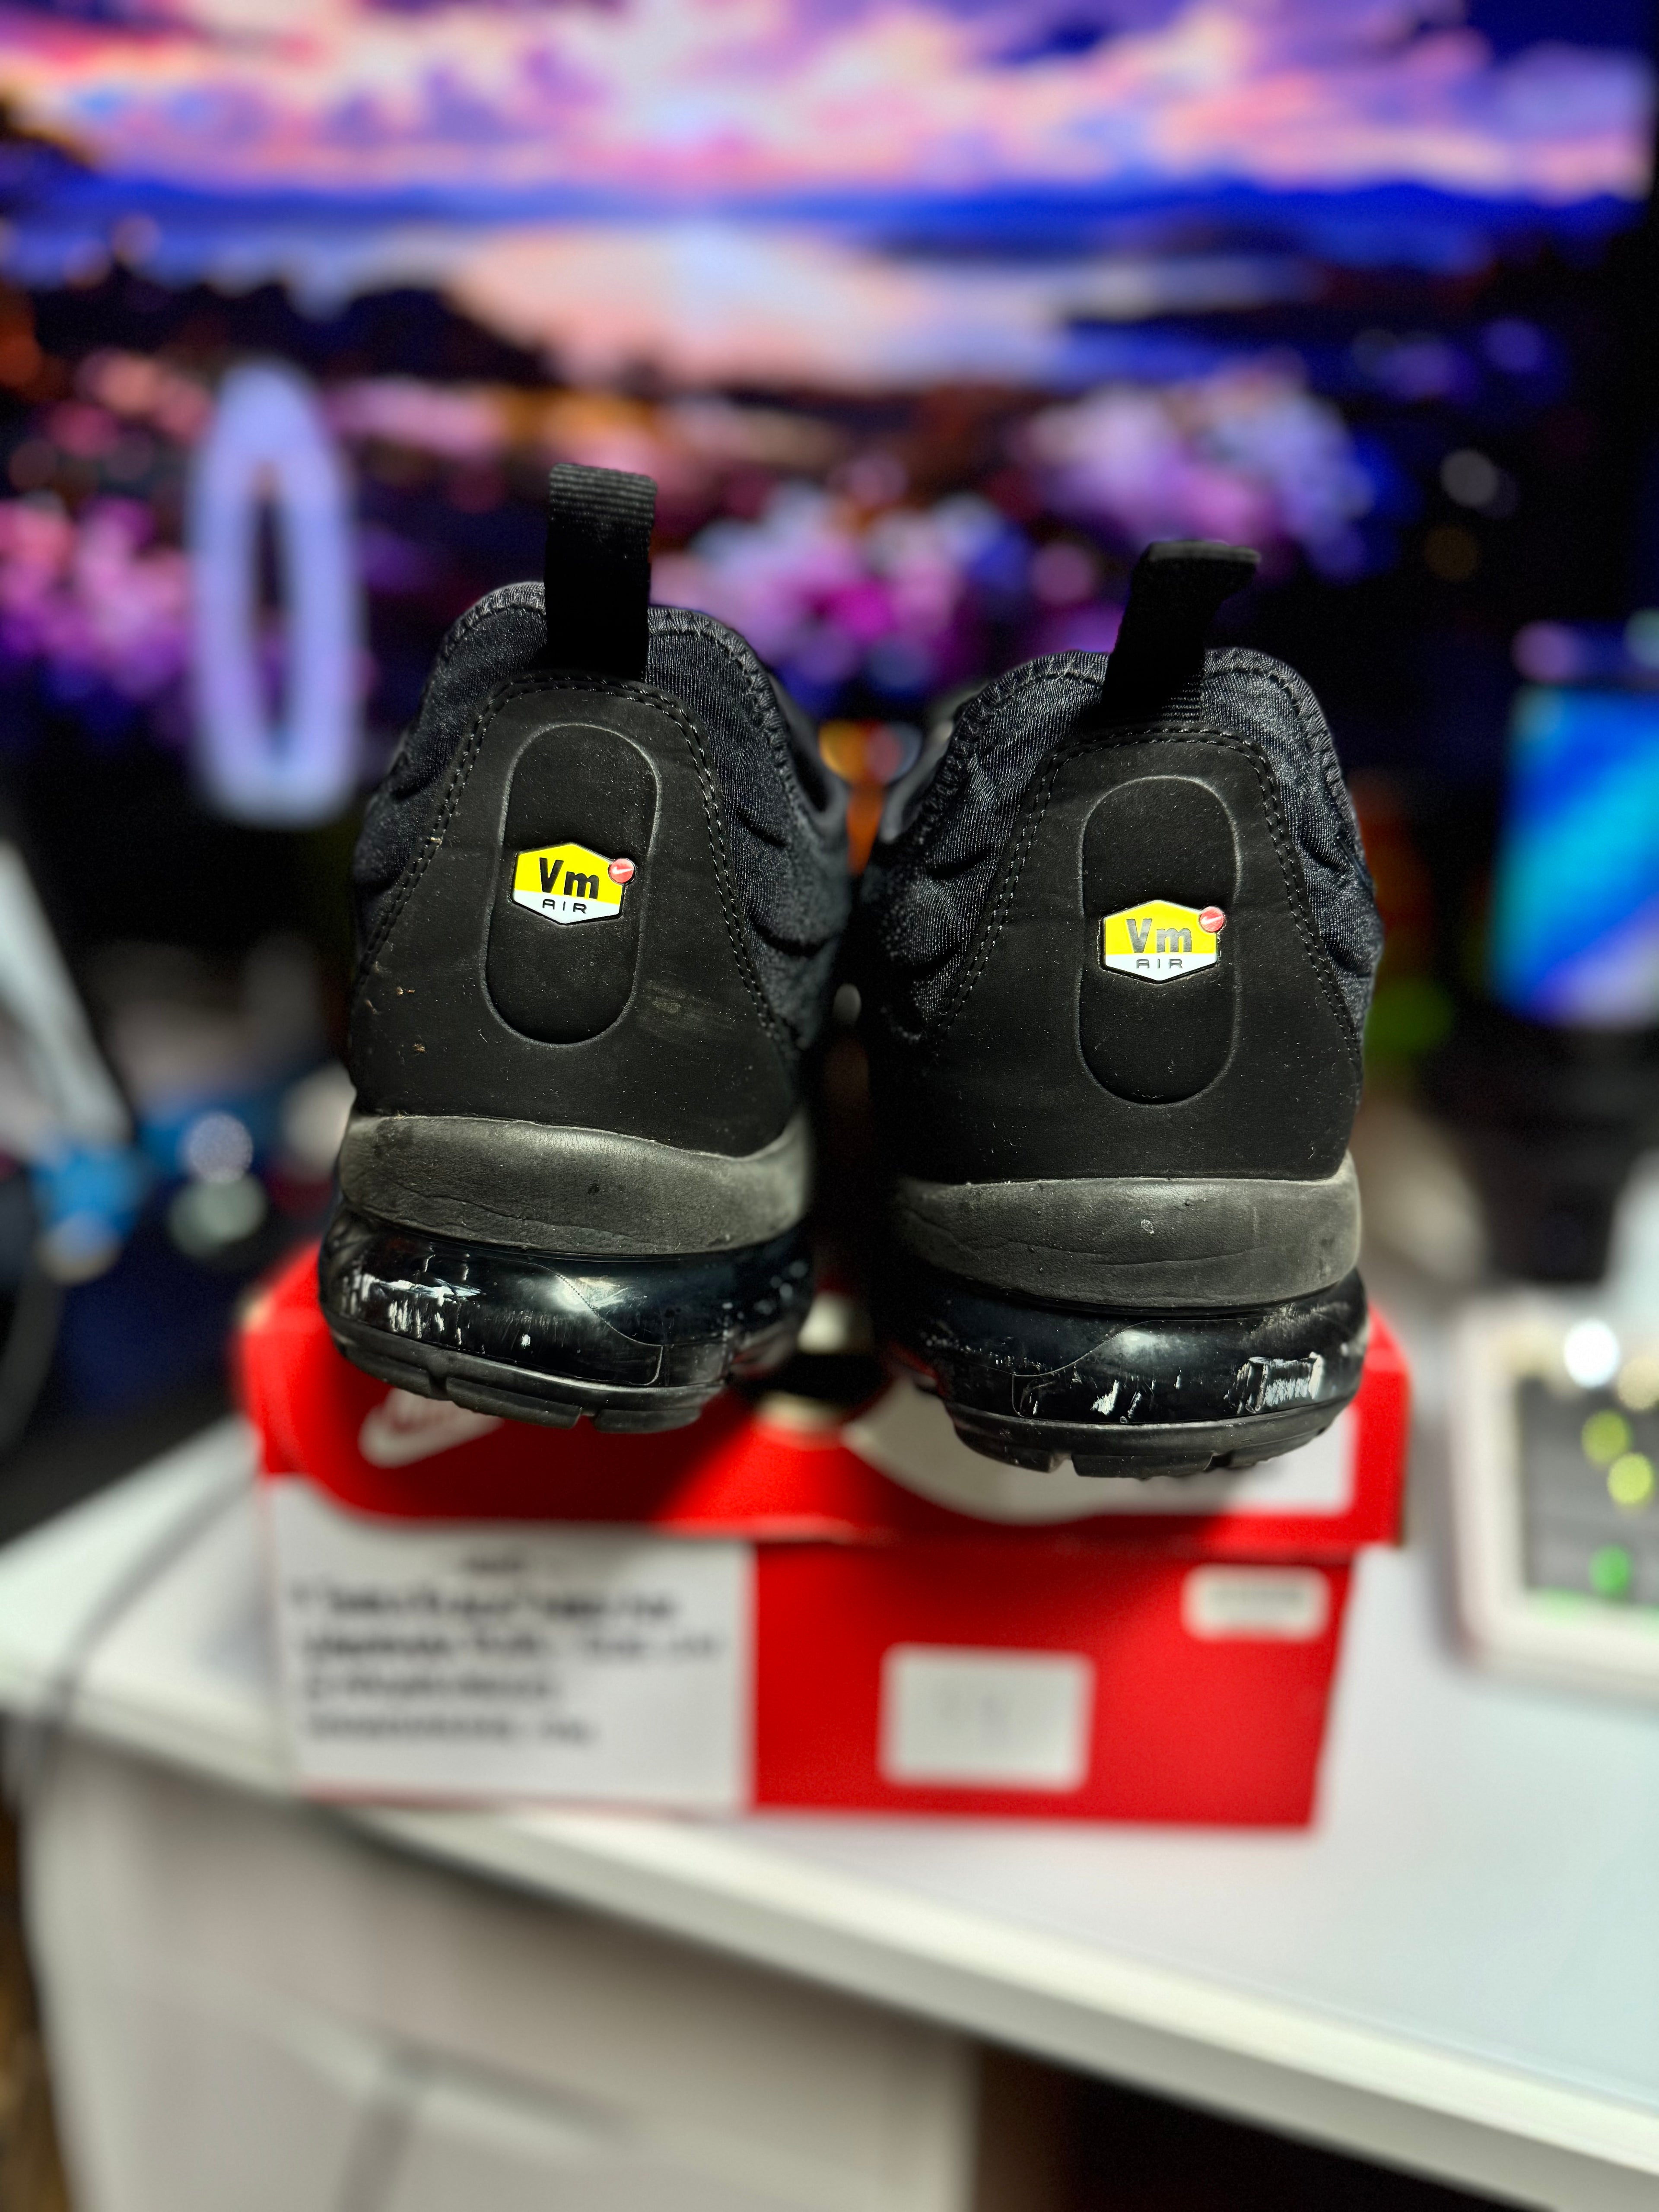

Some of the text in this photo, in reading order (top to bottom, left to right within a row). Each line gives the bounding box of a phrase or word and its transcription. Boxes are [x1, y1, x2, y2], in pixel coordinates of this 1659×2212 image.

[539, 857, 599, 899] Vm
[542, 899, 587, 914] AIR
[1126, 918, 1192, 953] Vm
[1135, 958, 1183, 969] AIR
